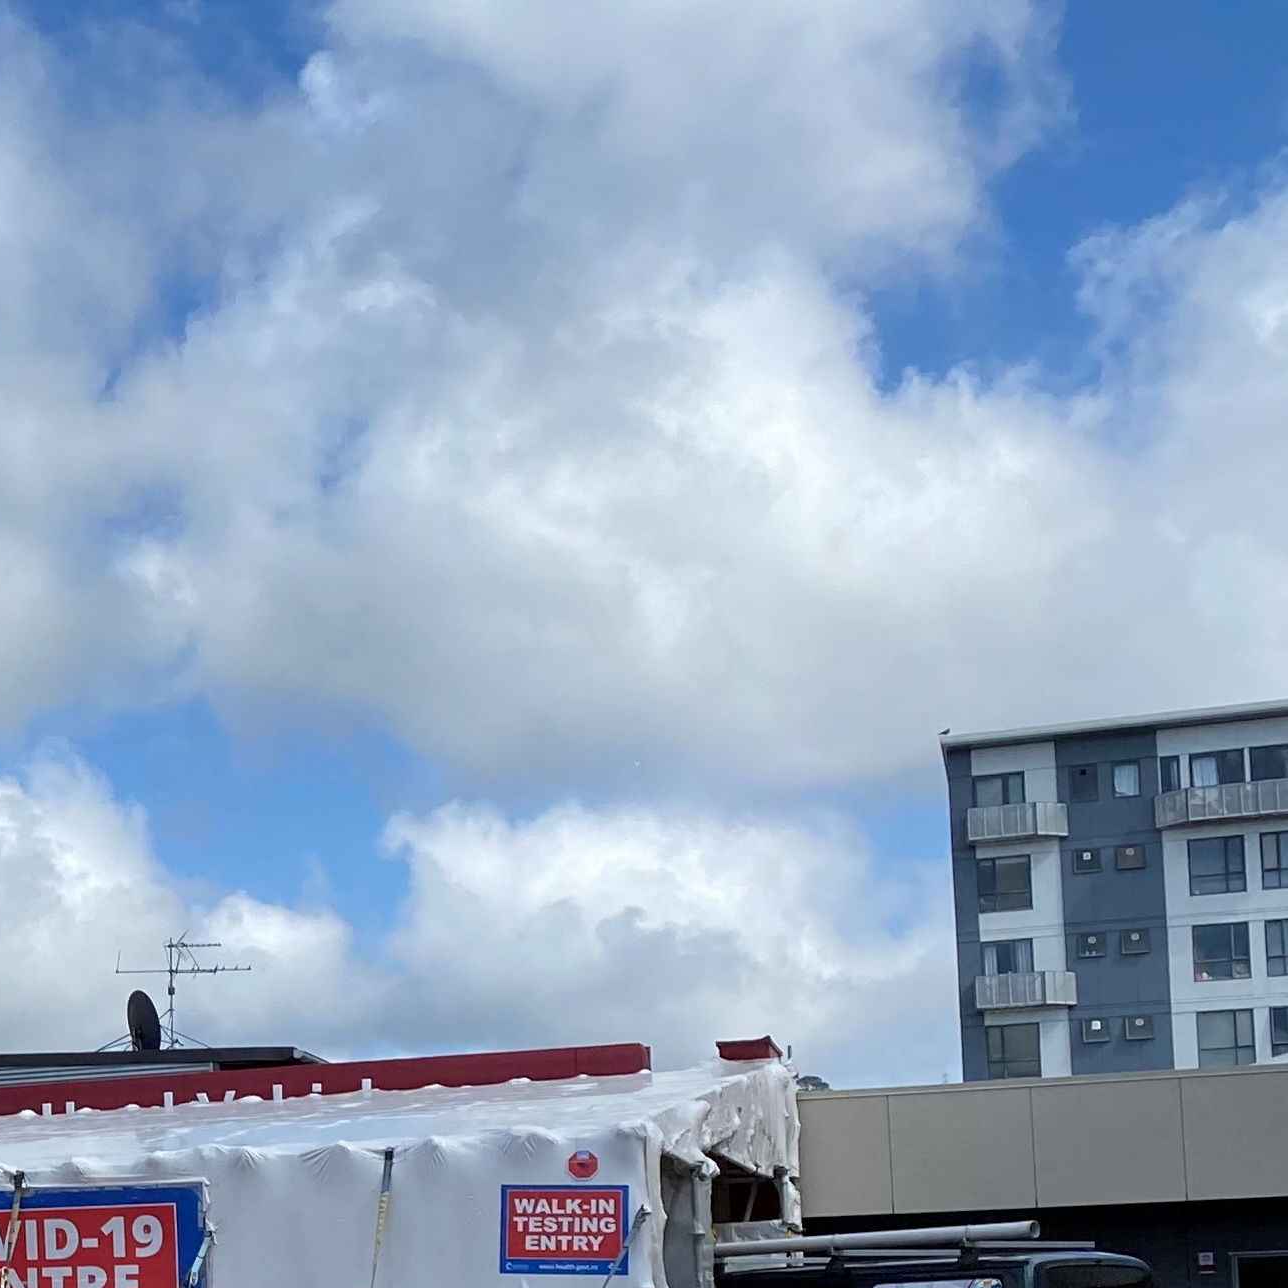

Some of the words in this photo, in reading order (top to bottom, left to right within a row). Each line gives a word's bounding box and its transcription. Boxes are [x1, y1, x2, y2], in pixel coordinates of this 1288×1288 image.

[513, 1198, 615, 1215] WALK-IN
[513, 1216, 617, 1233] TESTING
[525, 1235, 604, 1251] ENTRY
